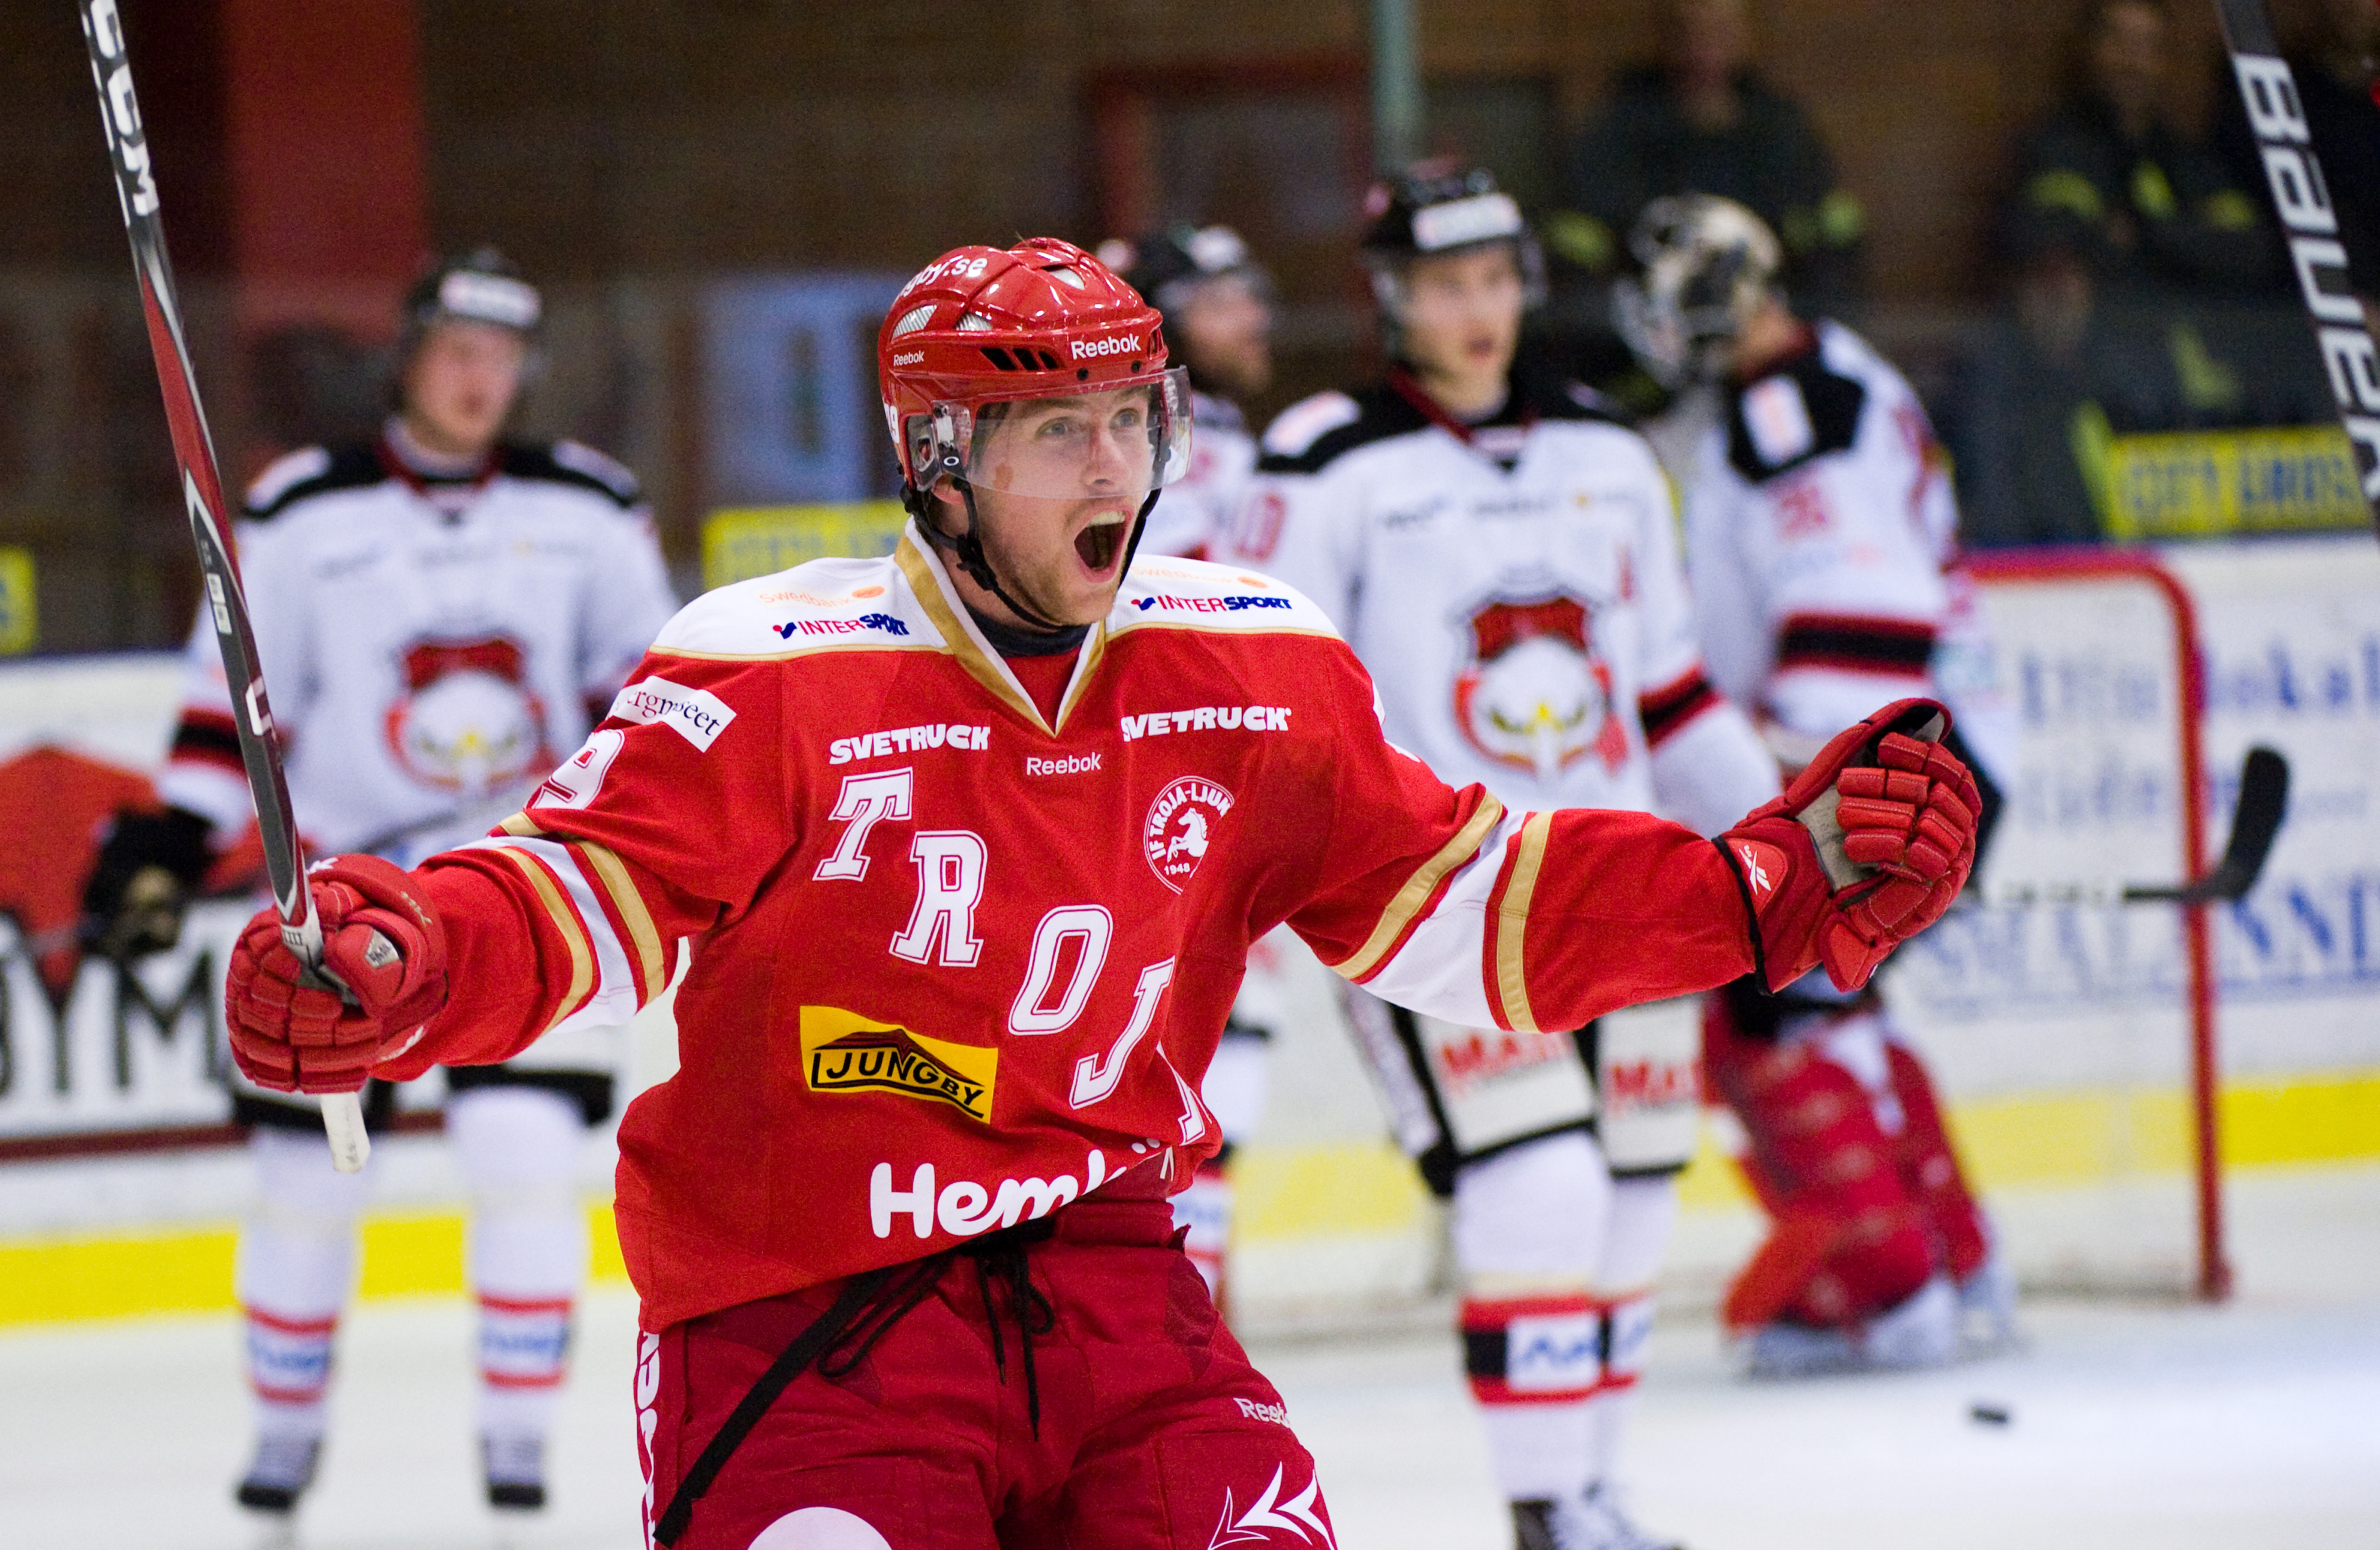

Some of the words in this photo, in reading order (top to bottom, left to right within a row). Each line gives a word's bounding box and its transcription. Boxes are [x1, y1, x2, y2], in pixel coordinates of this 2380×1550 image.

[901, 257, 988, 297] gby.se
[893, 350, 925, 367] Reebok
[1071, 335, 1141, 360] Reebok
[1157, 595, 1293, 613] INTERSPORT
[797, 613, 910, 636] INTERSPORT
[1121, 705, 1289, 742] SVETRUCK
[829, 724, 990, 765] SVETRUCK
[1026, 752, 1102, 776] Reebok
[1149, 782, 1231, 838] TROJA-LJUN
[1149, 840, 1167, 861] IF
[1164, 862, 1191, 876] 1948
[811, 1046, 985, 1119] LJUNGBY
[870, 1137, 1161, 1240] Hem
[1233, 1397, 1291, 1429] Reeb
